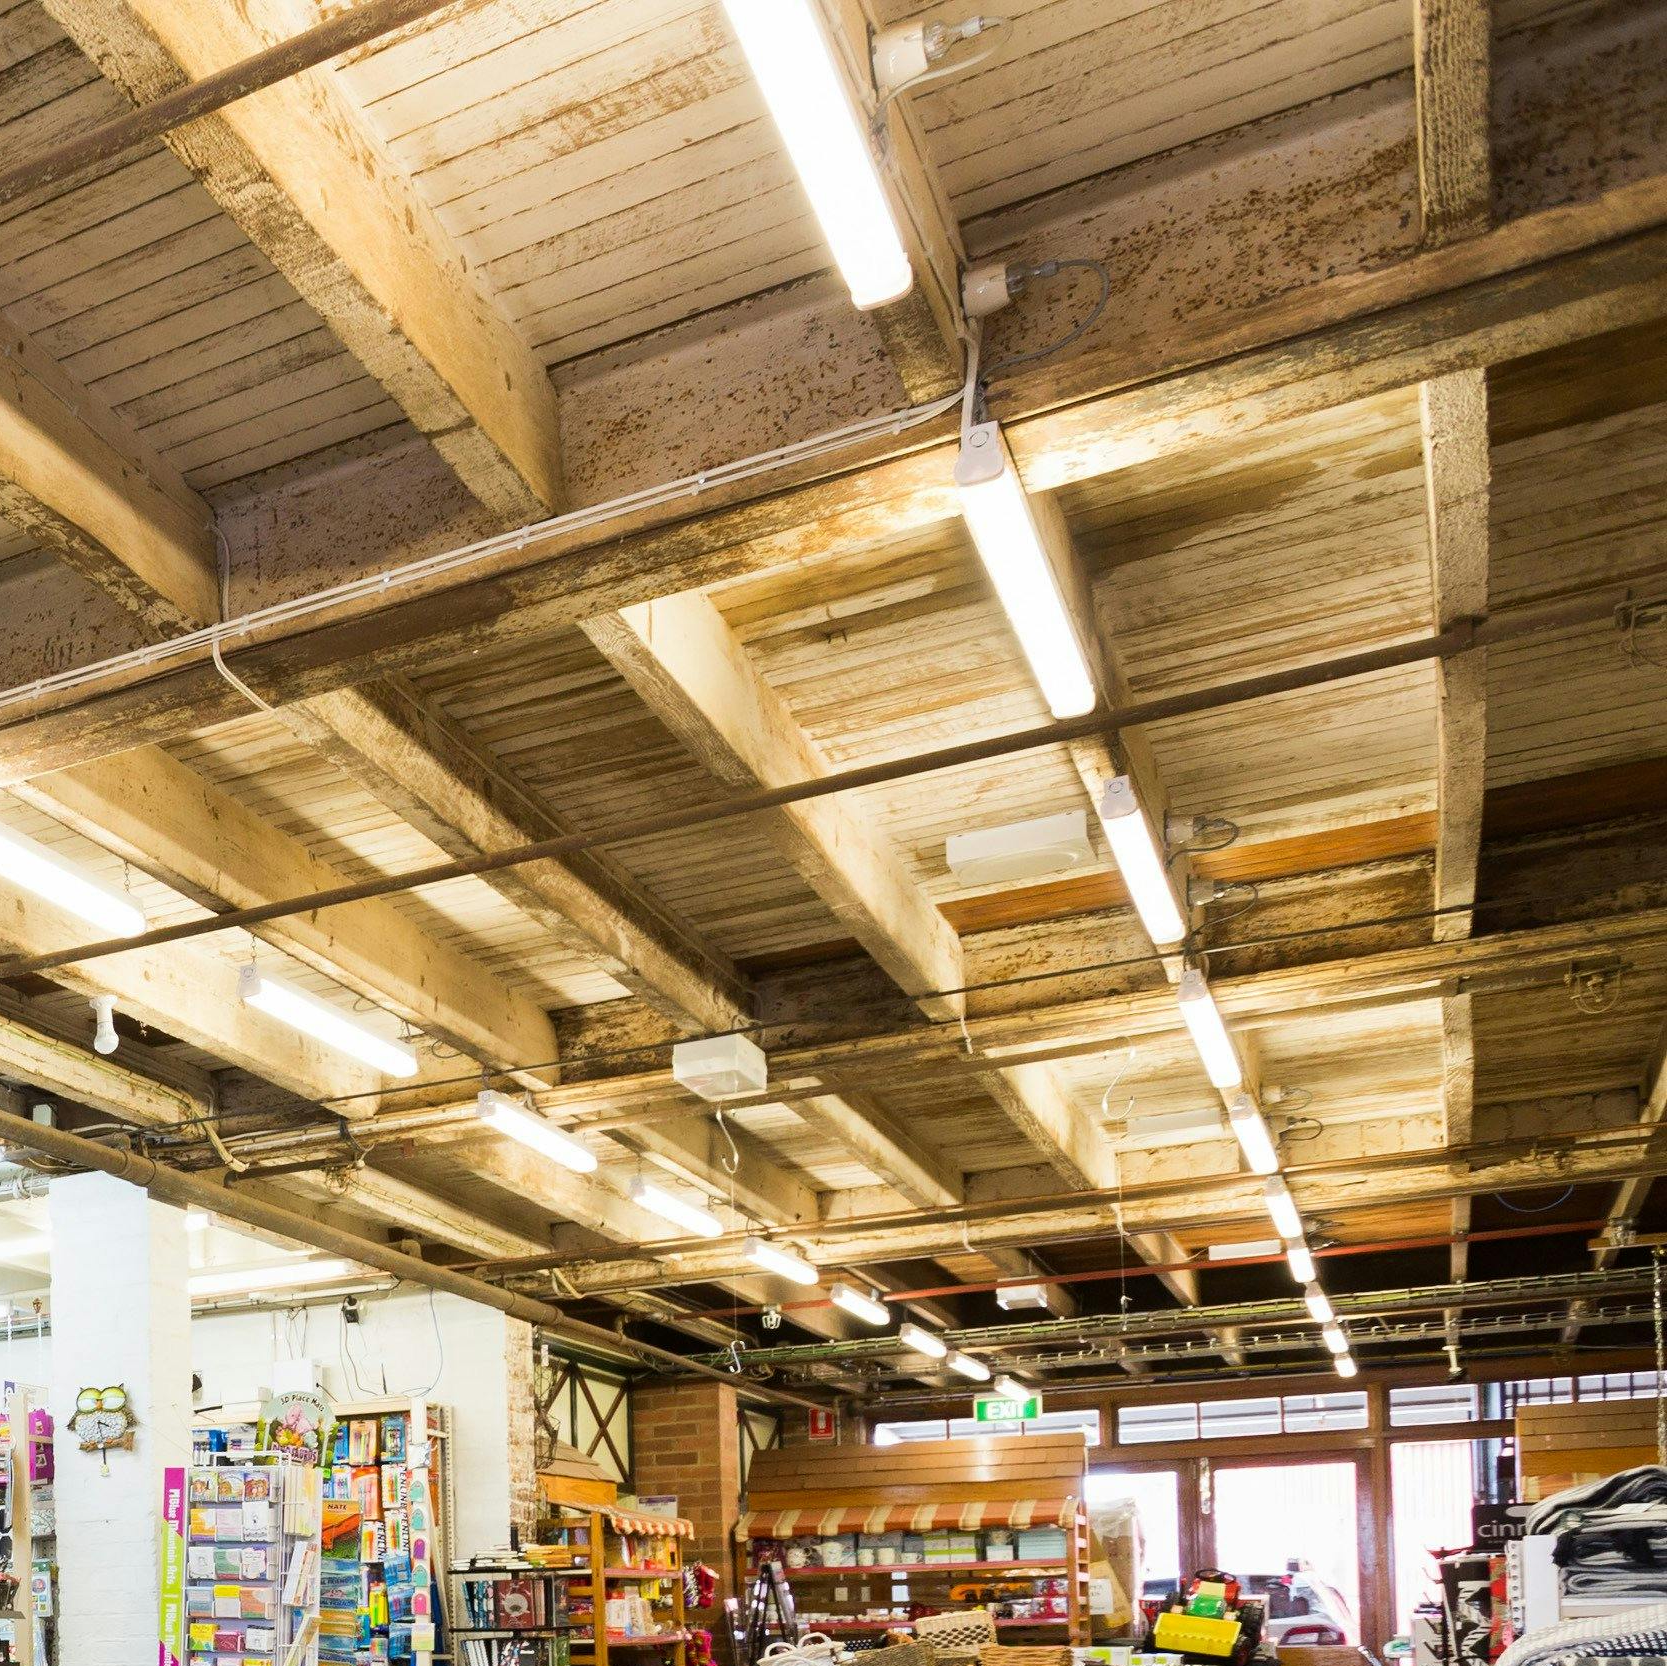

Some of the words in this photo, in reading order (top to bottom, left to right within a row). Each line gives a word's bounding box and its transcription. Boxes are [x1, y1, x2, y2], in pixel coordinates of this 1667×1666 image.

[985, 1401, 1026, 1418] EXIT
[168, 1496, 181, 1519] Blue
[327, 1503, 347, 1511] NATE
[166, 1520, 179, 1568] Mountain
[165, 1610, 177, 1633] Blue
